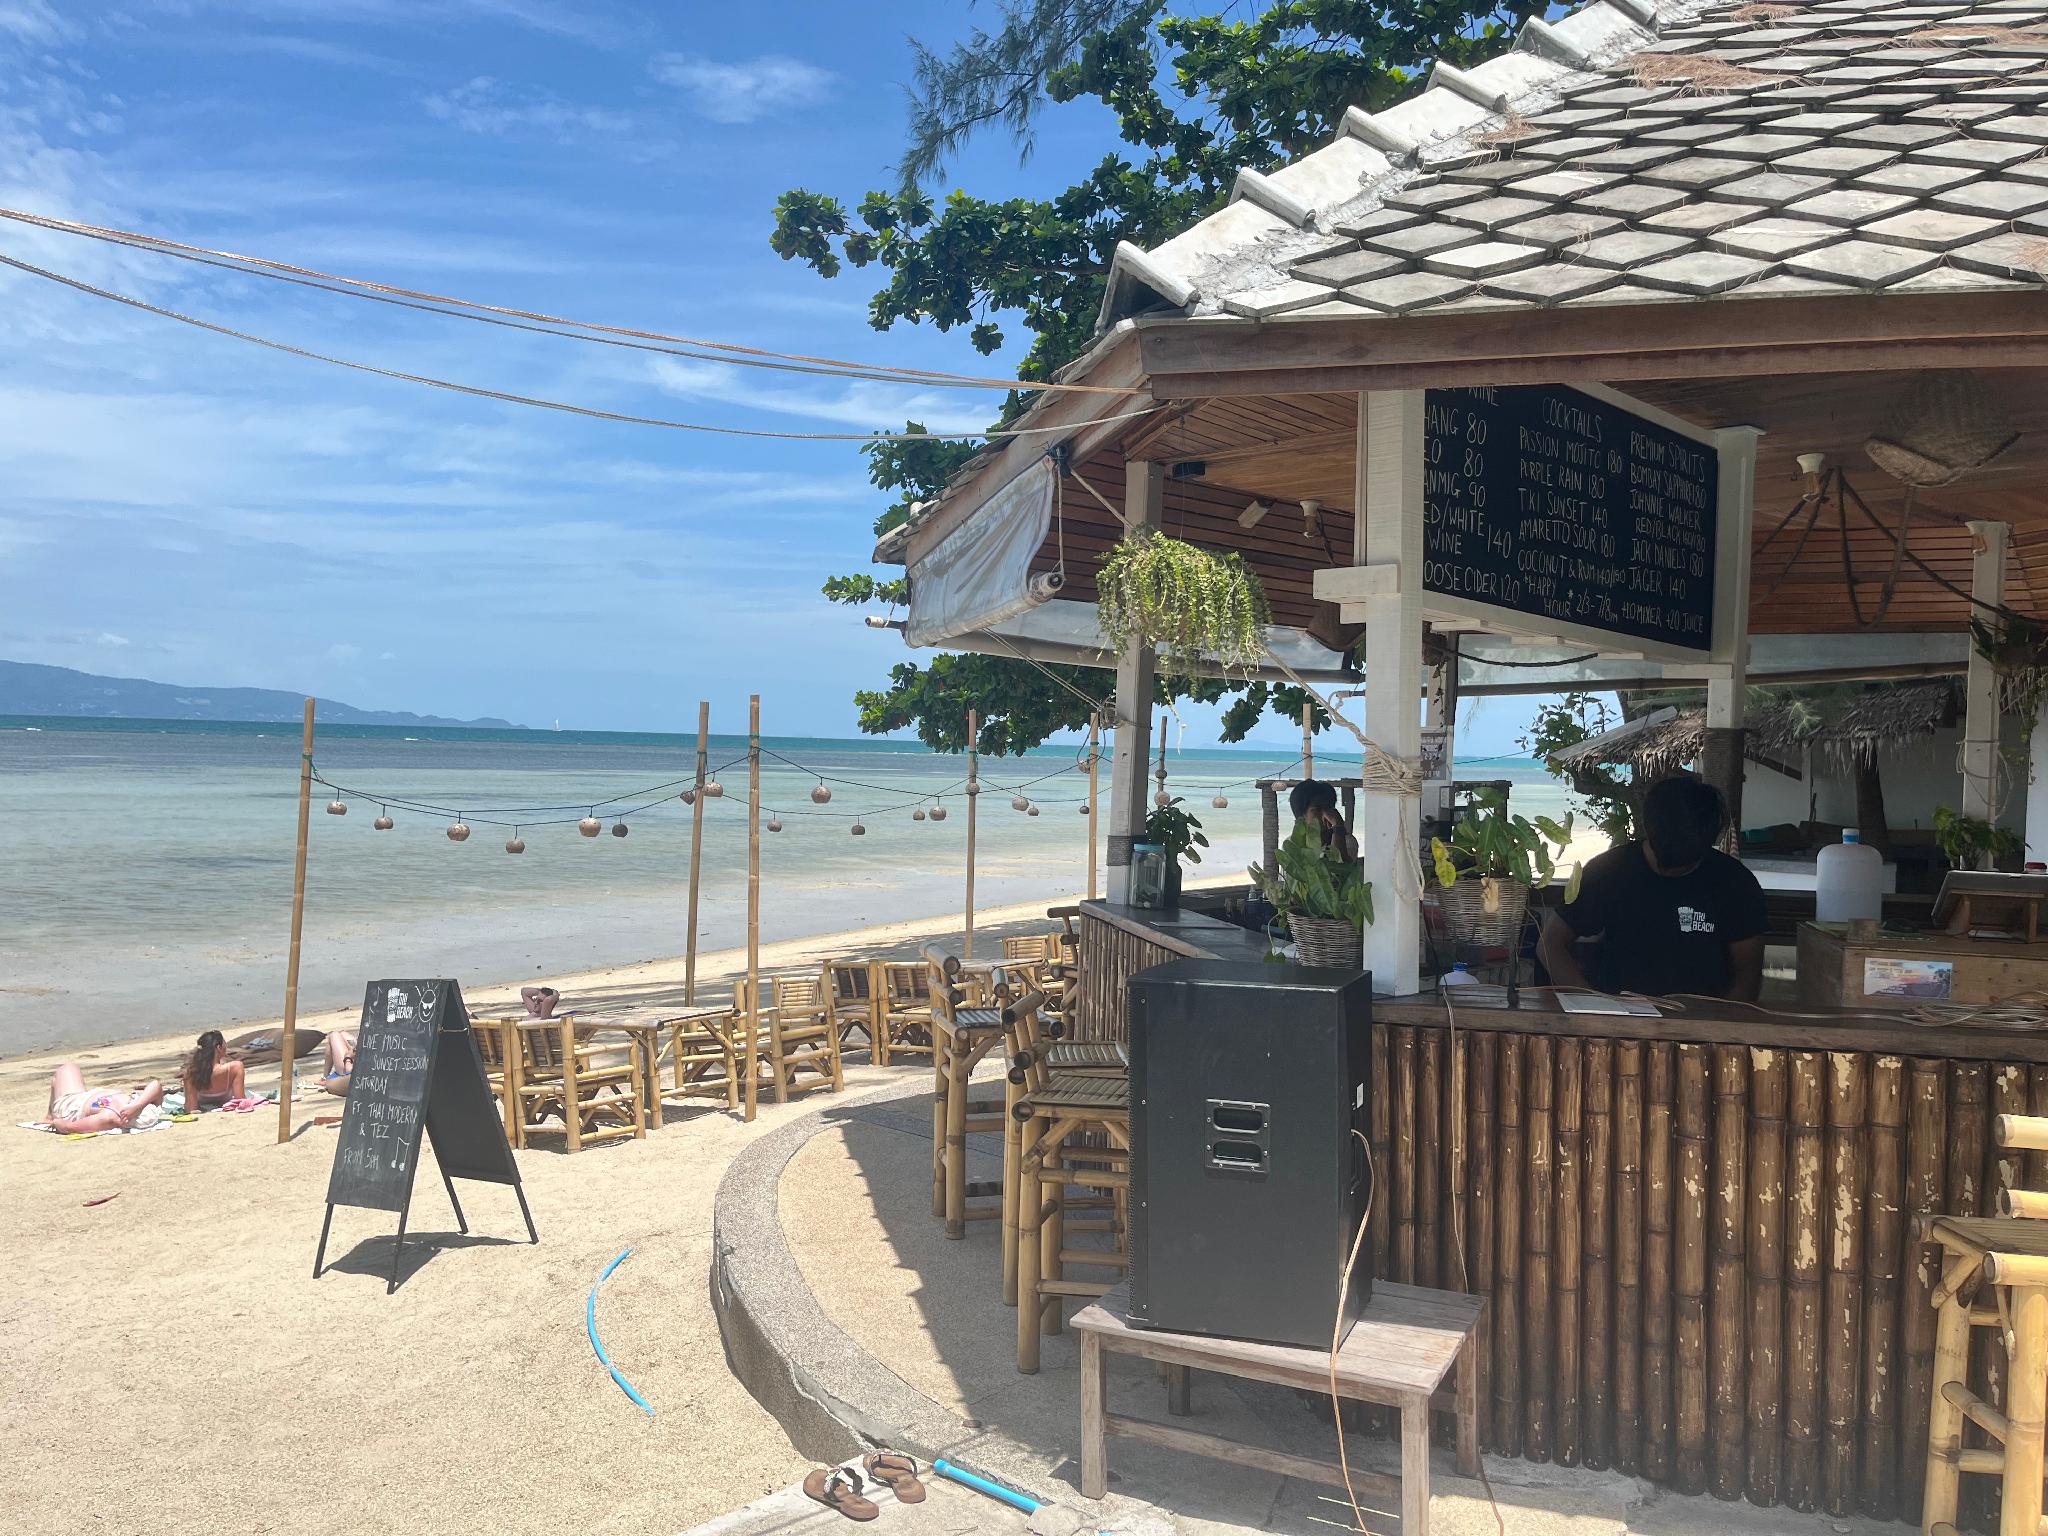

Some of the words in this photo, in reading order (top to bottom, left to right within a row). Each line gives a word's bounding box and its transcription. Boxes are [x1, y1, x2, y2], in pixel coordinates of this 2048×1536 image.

[1466, 412, 1487, 445] 80
[1543, 396, 1602, 443] COCKTAILS
[1463, 447, 1484, 477] 80
[1519, 425, 1559, 459] PASSION
[1566, 440, 1601, 469] MOJITO
[1607, 449, 1623, 475] 180
[1630, 430, 1666, 465] PREMIUM
[1668, 441, 1705, 484] SPIRITS
[1469, 481, 1486, 507] 90
[1558, 465, 1583, 492] RAIN
[1588, 473, 1605, 499] 180
[1630, 461, 1662, 495] BOMBAY
[1547, 490, 1588, 523] SUNSET
[1592, 505, 1608, 530] 140
[1629, 488, 1666, 519] JOHNNIE
[1668, 503, 1702, 532] WALKER
[1428, 527, 1462, 555] WINE
[1487, 523, 1512, 559] 140
[1518, 518, 1571, 545] AMARETTO
[1572, 523, 1597, 553] SOUR
[1600, 533, 1616, 558] 180
[1517, 549, 1568, 579] COCONUT
[1578, 558, 1595, 582] RUM
[1630, 538, 1652, 564] JACK
[1654, 542, 1686, 570] DANIELS
[1689, 552, 1705, 579] 180
[1464, 566, 1497, 597] CIDER
[1500, 573, 1520, 604] 120
[1669, 575, 1686, 601] 140
[1692, 920, 1715, 933] BEACH
[362, 1033, 380, 1051] LIVE
[381, 1034, 408, 1053] MUSIC
[371, 1053, 401, 1072] SUNSET
[354, 1074, 390, 1096] SATURDAY
[367, 1101, 386, 1122] THAI
[370, 1122, 390, 1140] TEZ
